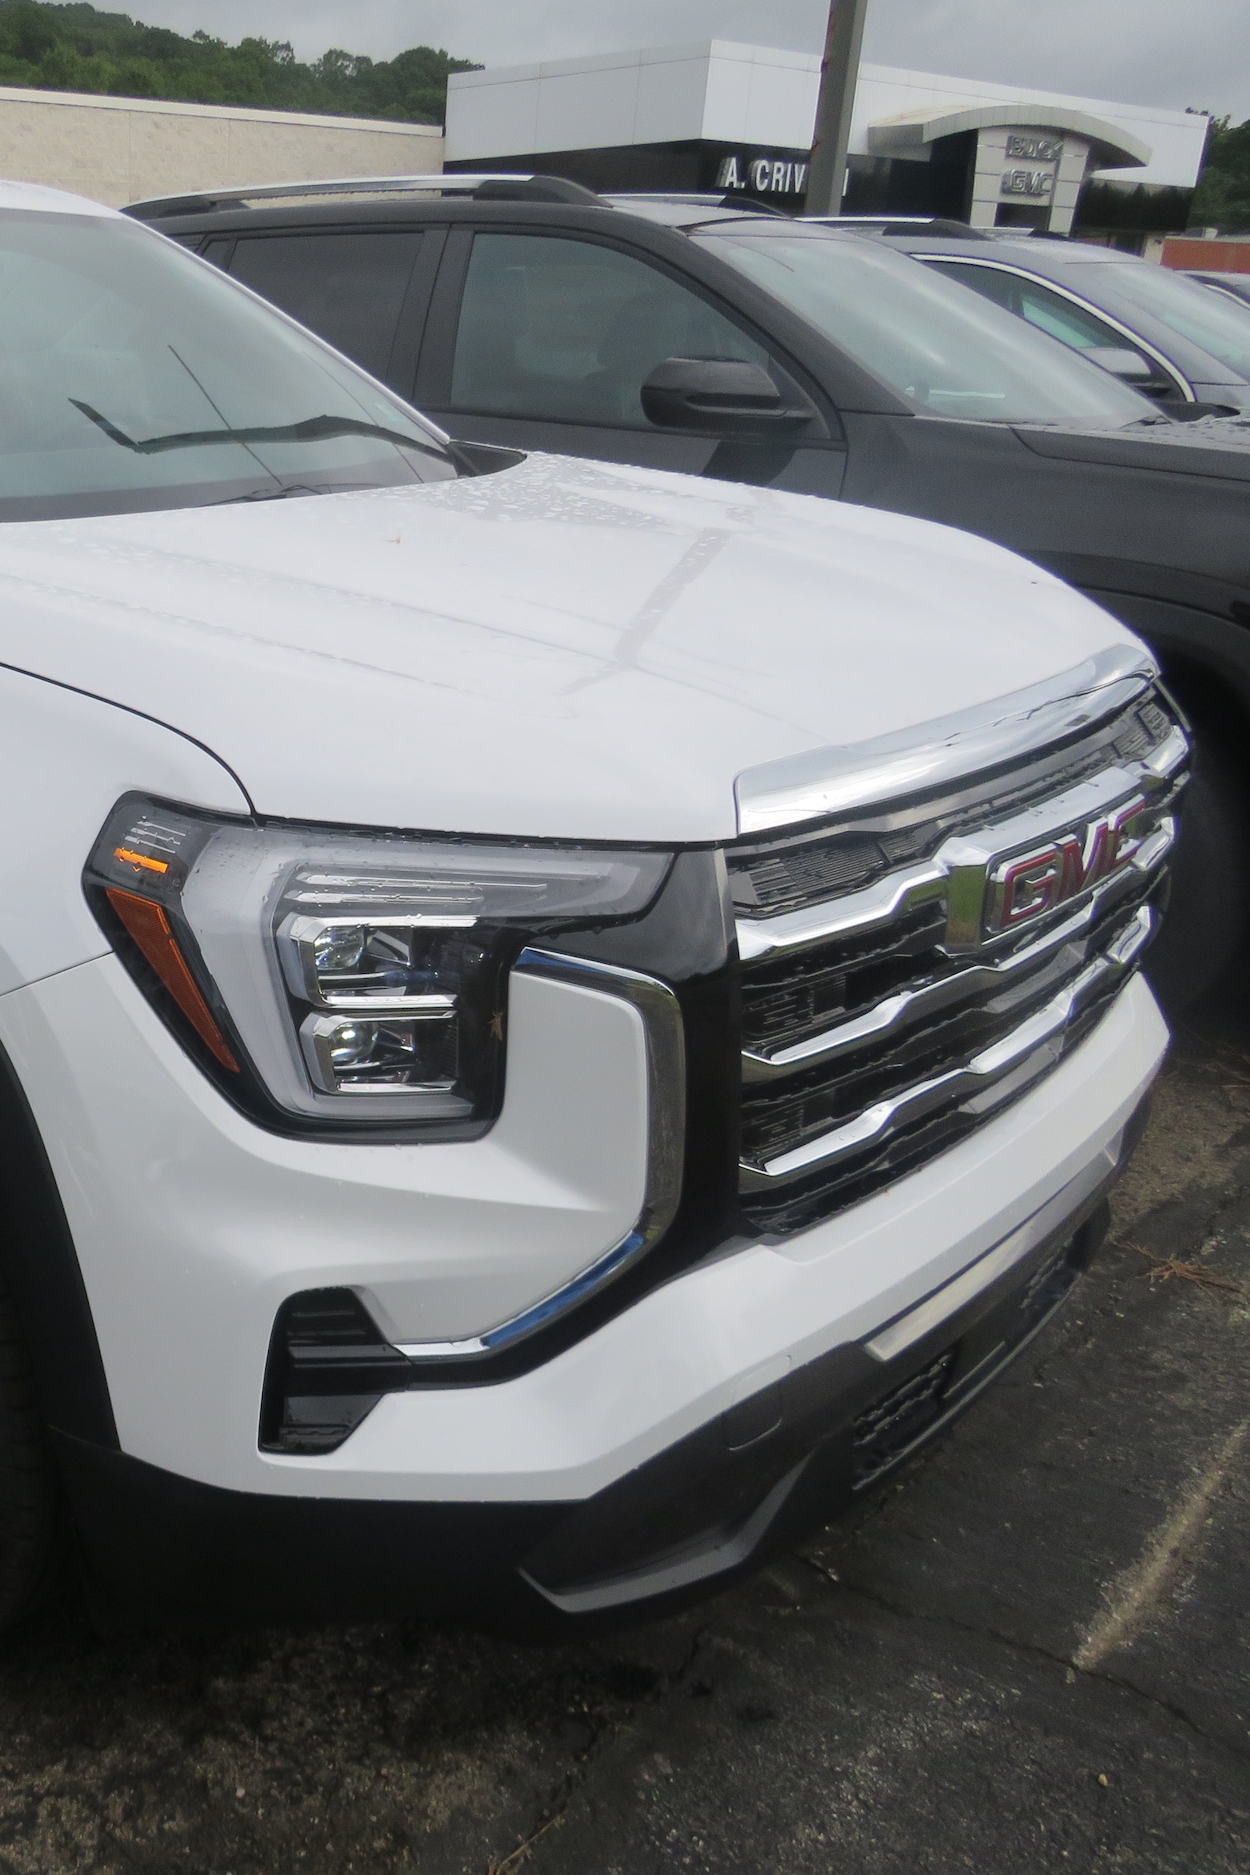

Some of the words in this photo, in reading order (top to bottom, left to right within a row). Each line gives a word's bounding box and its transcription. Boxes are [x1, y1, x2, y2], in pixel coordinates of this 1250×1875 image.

[723, 156, 746, 189] A.
[1006, 169, 1054, 195] GMC
[996, 793, 1147, 933] GMC
